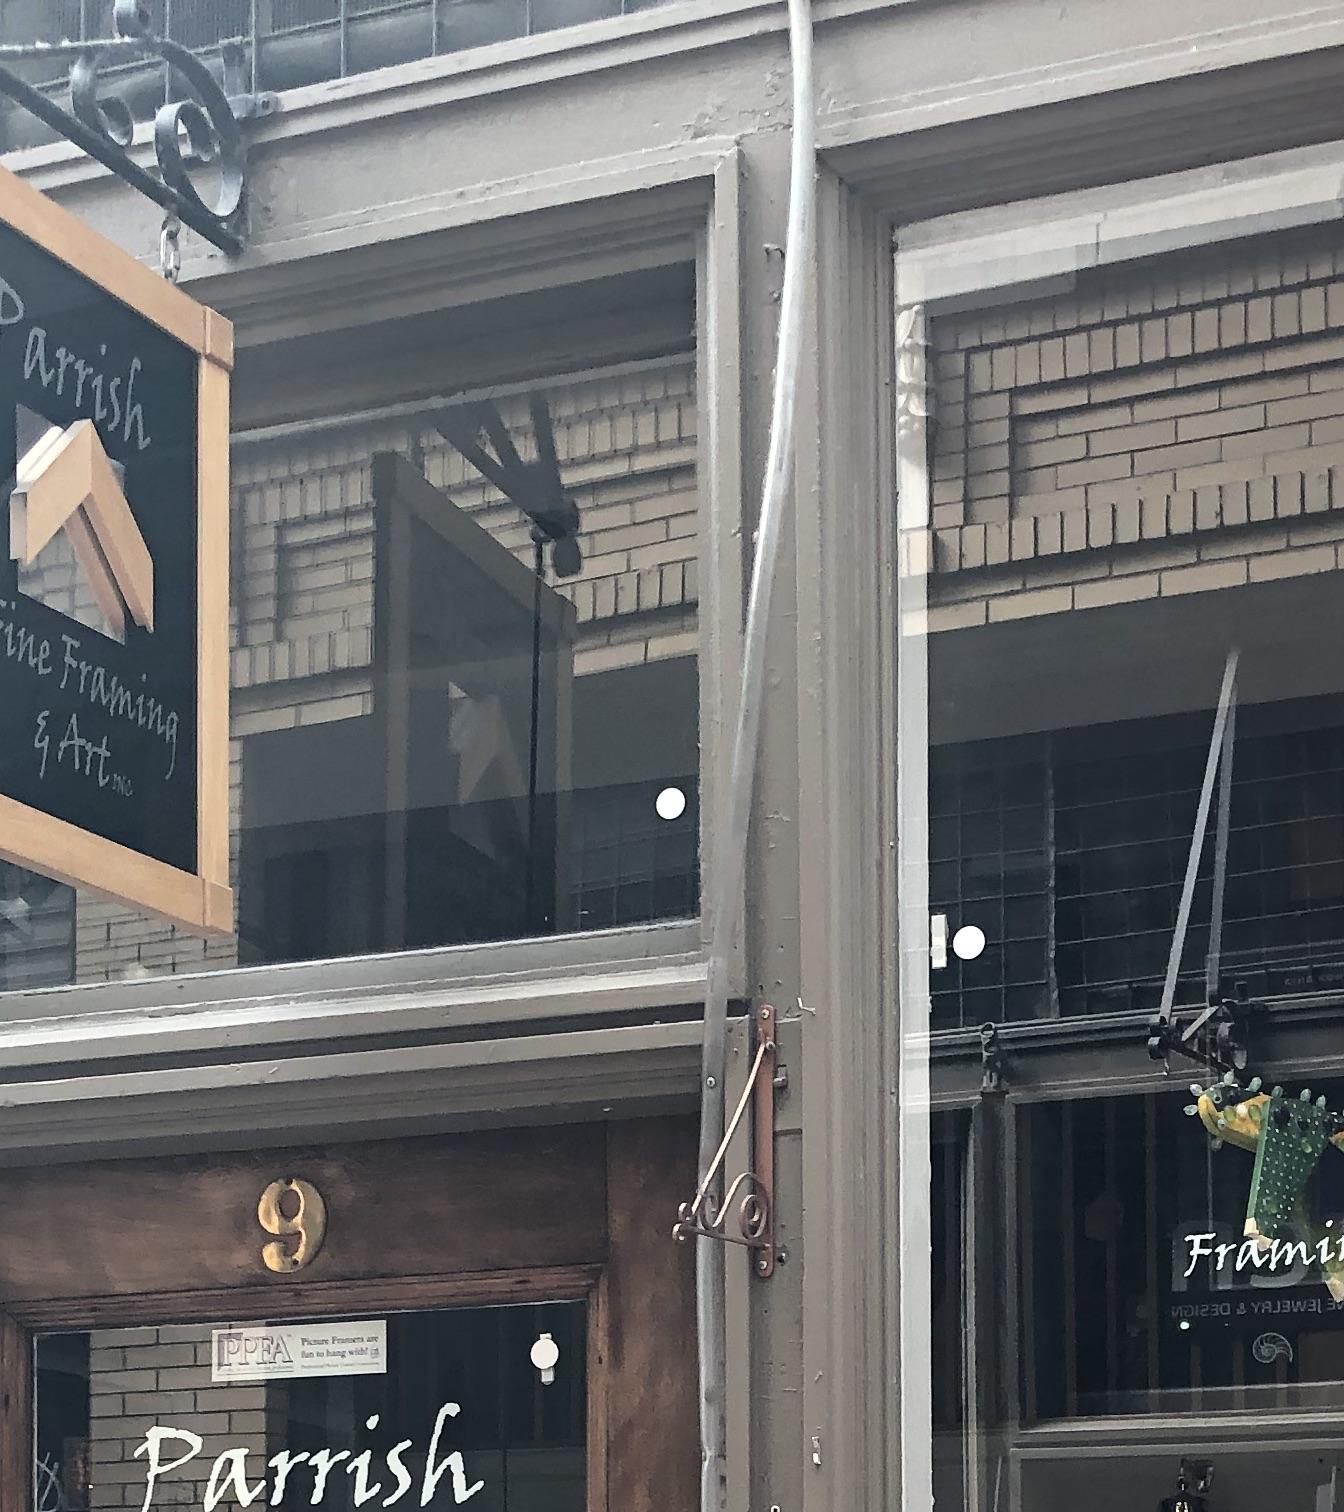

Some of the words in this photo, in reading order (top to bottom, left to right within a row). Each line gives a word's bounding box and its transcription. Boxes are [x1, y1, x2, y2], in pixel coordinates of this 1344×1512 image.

[58, 633, 181, 781] Framing
[34, 709, 51, 779] &
[58, 713, 112, 788] Art
[258, 1177, 327, 1274] 9
[220, 1334, 294, 1367] PPFA
[301, 1336, 329, 1346] Picture
[332, 1336, 364, 1346] Framers
[301, 1351, 314, 1359] fun
[326, 1349, 346, 1359] hang
